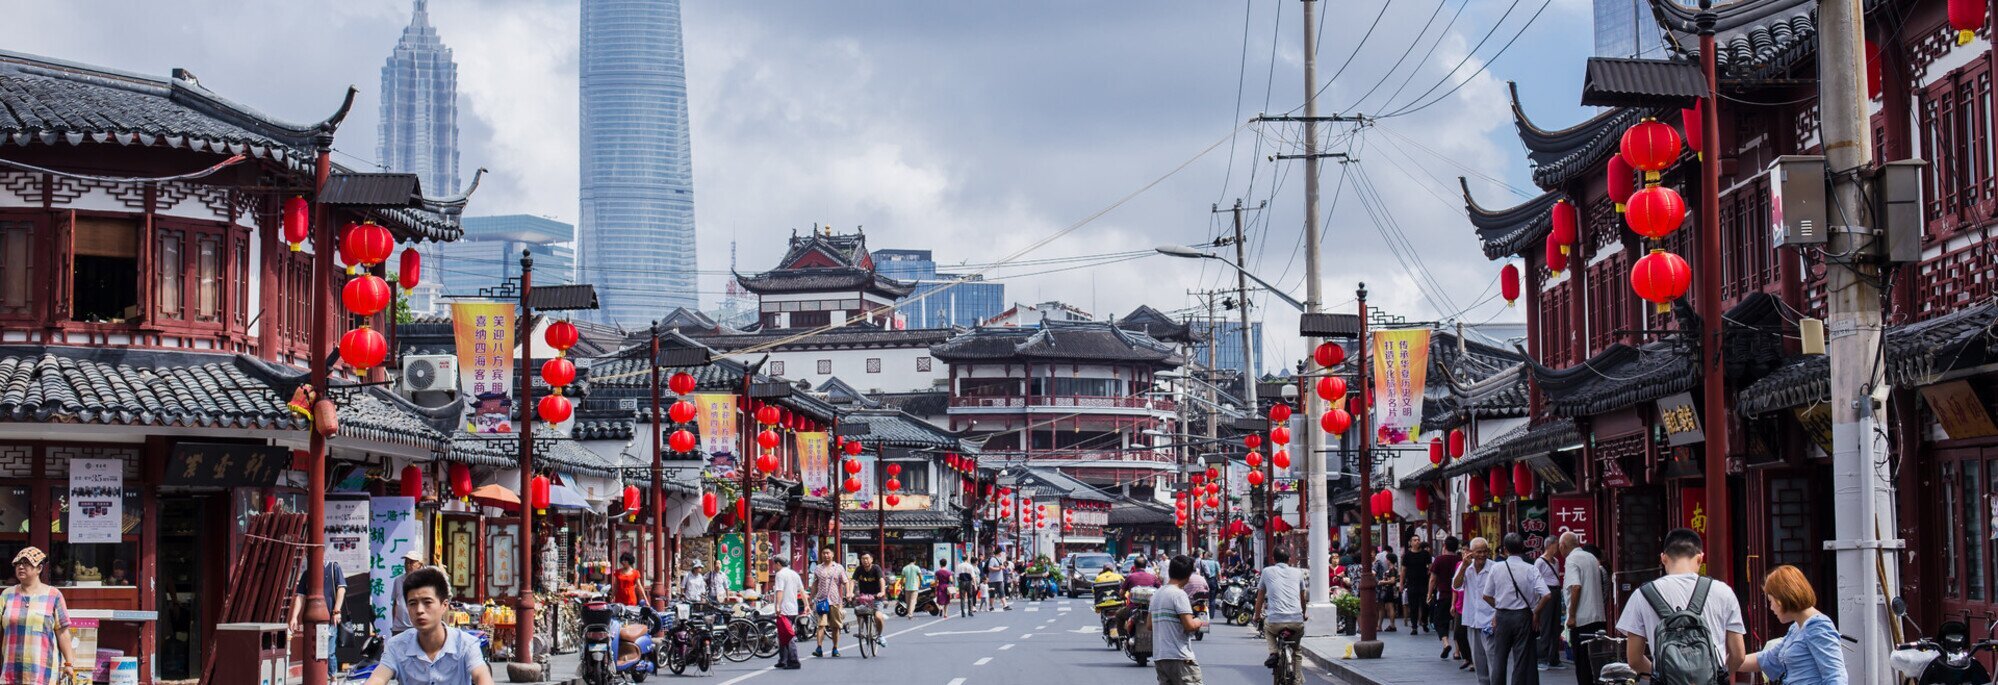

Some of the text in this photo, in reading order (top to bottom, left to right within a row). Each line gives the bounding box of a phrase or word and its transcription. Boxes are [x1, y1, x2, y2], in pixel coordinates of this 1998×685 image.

[474, 315, 487, 394] 喜纳四海客商
[492, 315, 505, 394] 笑迎八方宾朋
[1384, 341, 1397, 417] 打造文化旅游名片
[1399, 340, 1412, 417] 传承华夏历史文明
[370, 510, 410, 523] 一赔十
[1556, 507, 1587, 523] 十元
[369, 527, 387, 633] 湖北绿松
